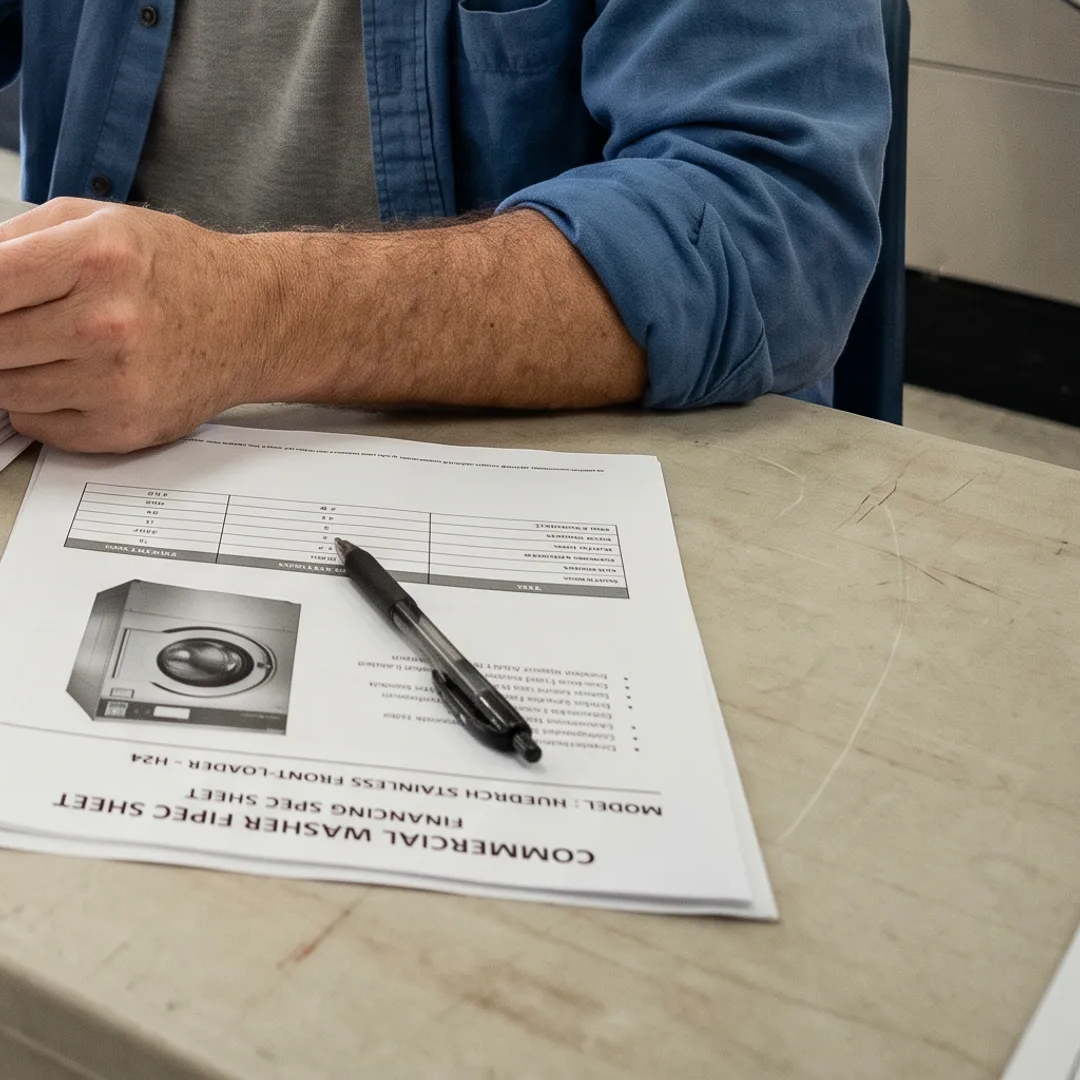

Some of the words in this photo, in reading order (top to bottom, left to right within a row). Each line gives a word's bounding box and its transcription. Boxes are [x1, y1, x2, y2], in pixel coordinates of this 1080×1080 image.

[131, 752, 169, 767] H24
[188, 759, 344, 787] FRONT-LOADER
[185, 787, 258, 807] SHEET
[351, 776, 459, 799] STAINLESS
[465, 788, 567, 809] HUEDRCH
[52, 792, 145, 817] SHEET
[152, 804, 234, 828] FIPEC
[265, 796, 322, 814] SPEC
[584, 799, 663, 817] MODEL
[330, 803, 465, 830] FINANCING
[243, 815, 372, 843] WASHER
[383, 829, 596, 866] COMMERCIAL
